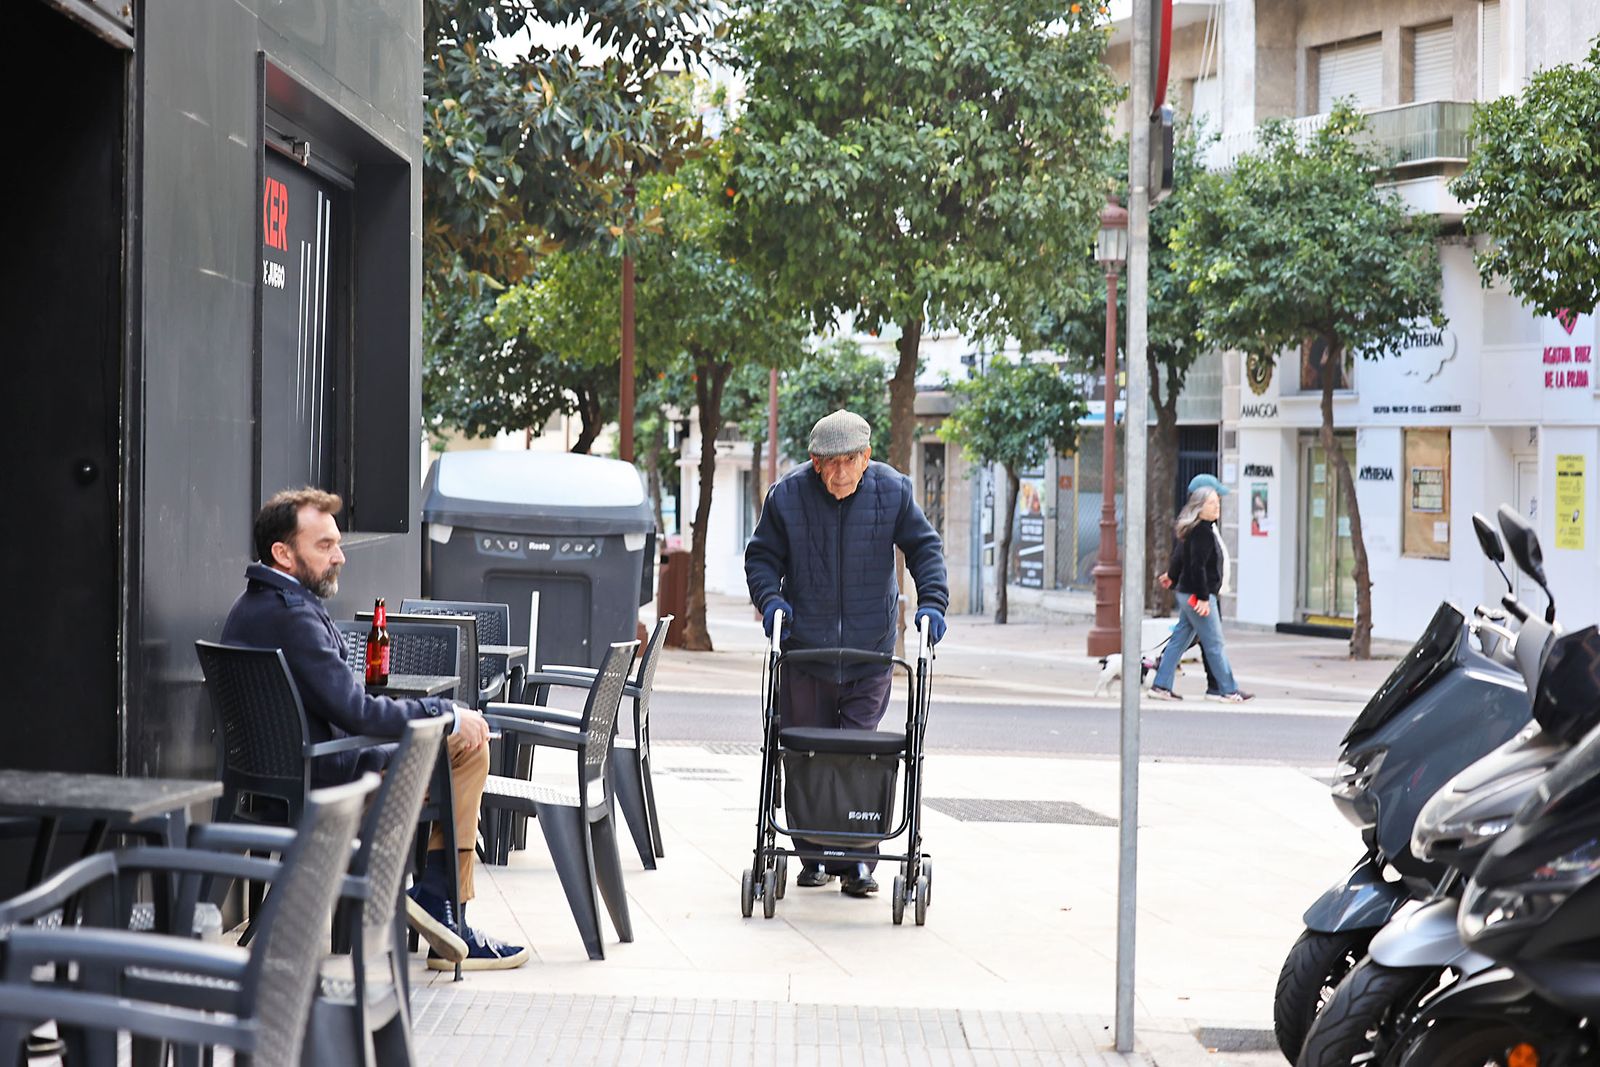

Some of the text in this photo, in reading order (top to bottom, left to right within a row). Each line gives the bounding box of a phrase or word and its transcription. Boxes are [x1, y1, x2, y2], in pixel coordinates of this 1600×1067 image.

[1542, 346, 1592, 364] AGATHA RUIZ
[1544, 370, 1589, 388] DE LA PRADA
[1243, 463, 1275, 478] ATHENA
[1359, 464, 1394, 481] ATHENA
[528, 541, 551, 551] Resto
